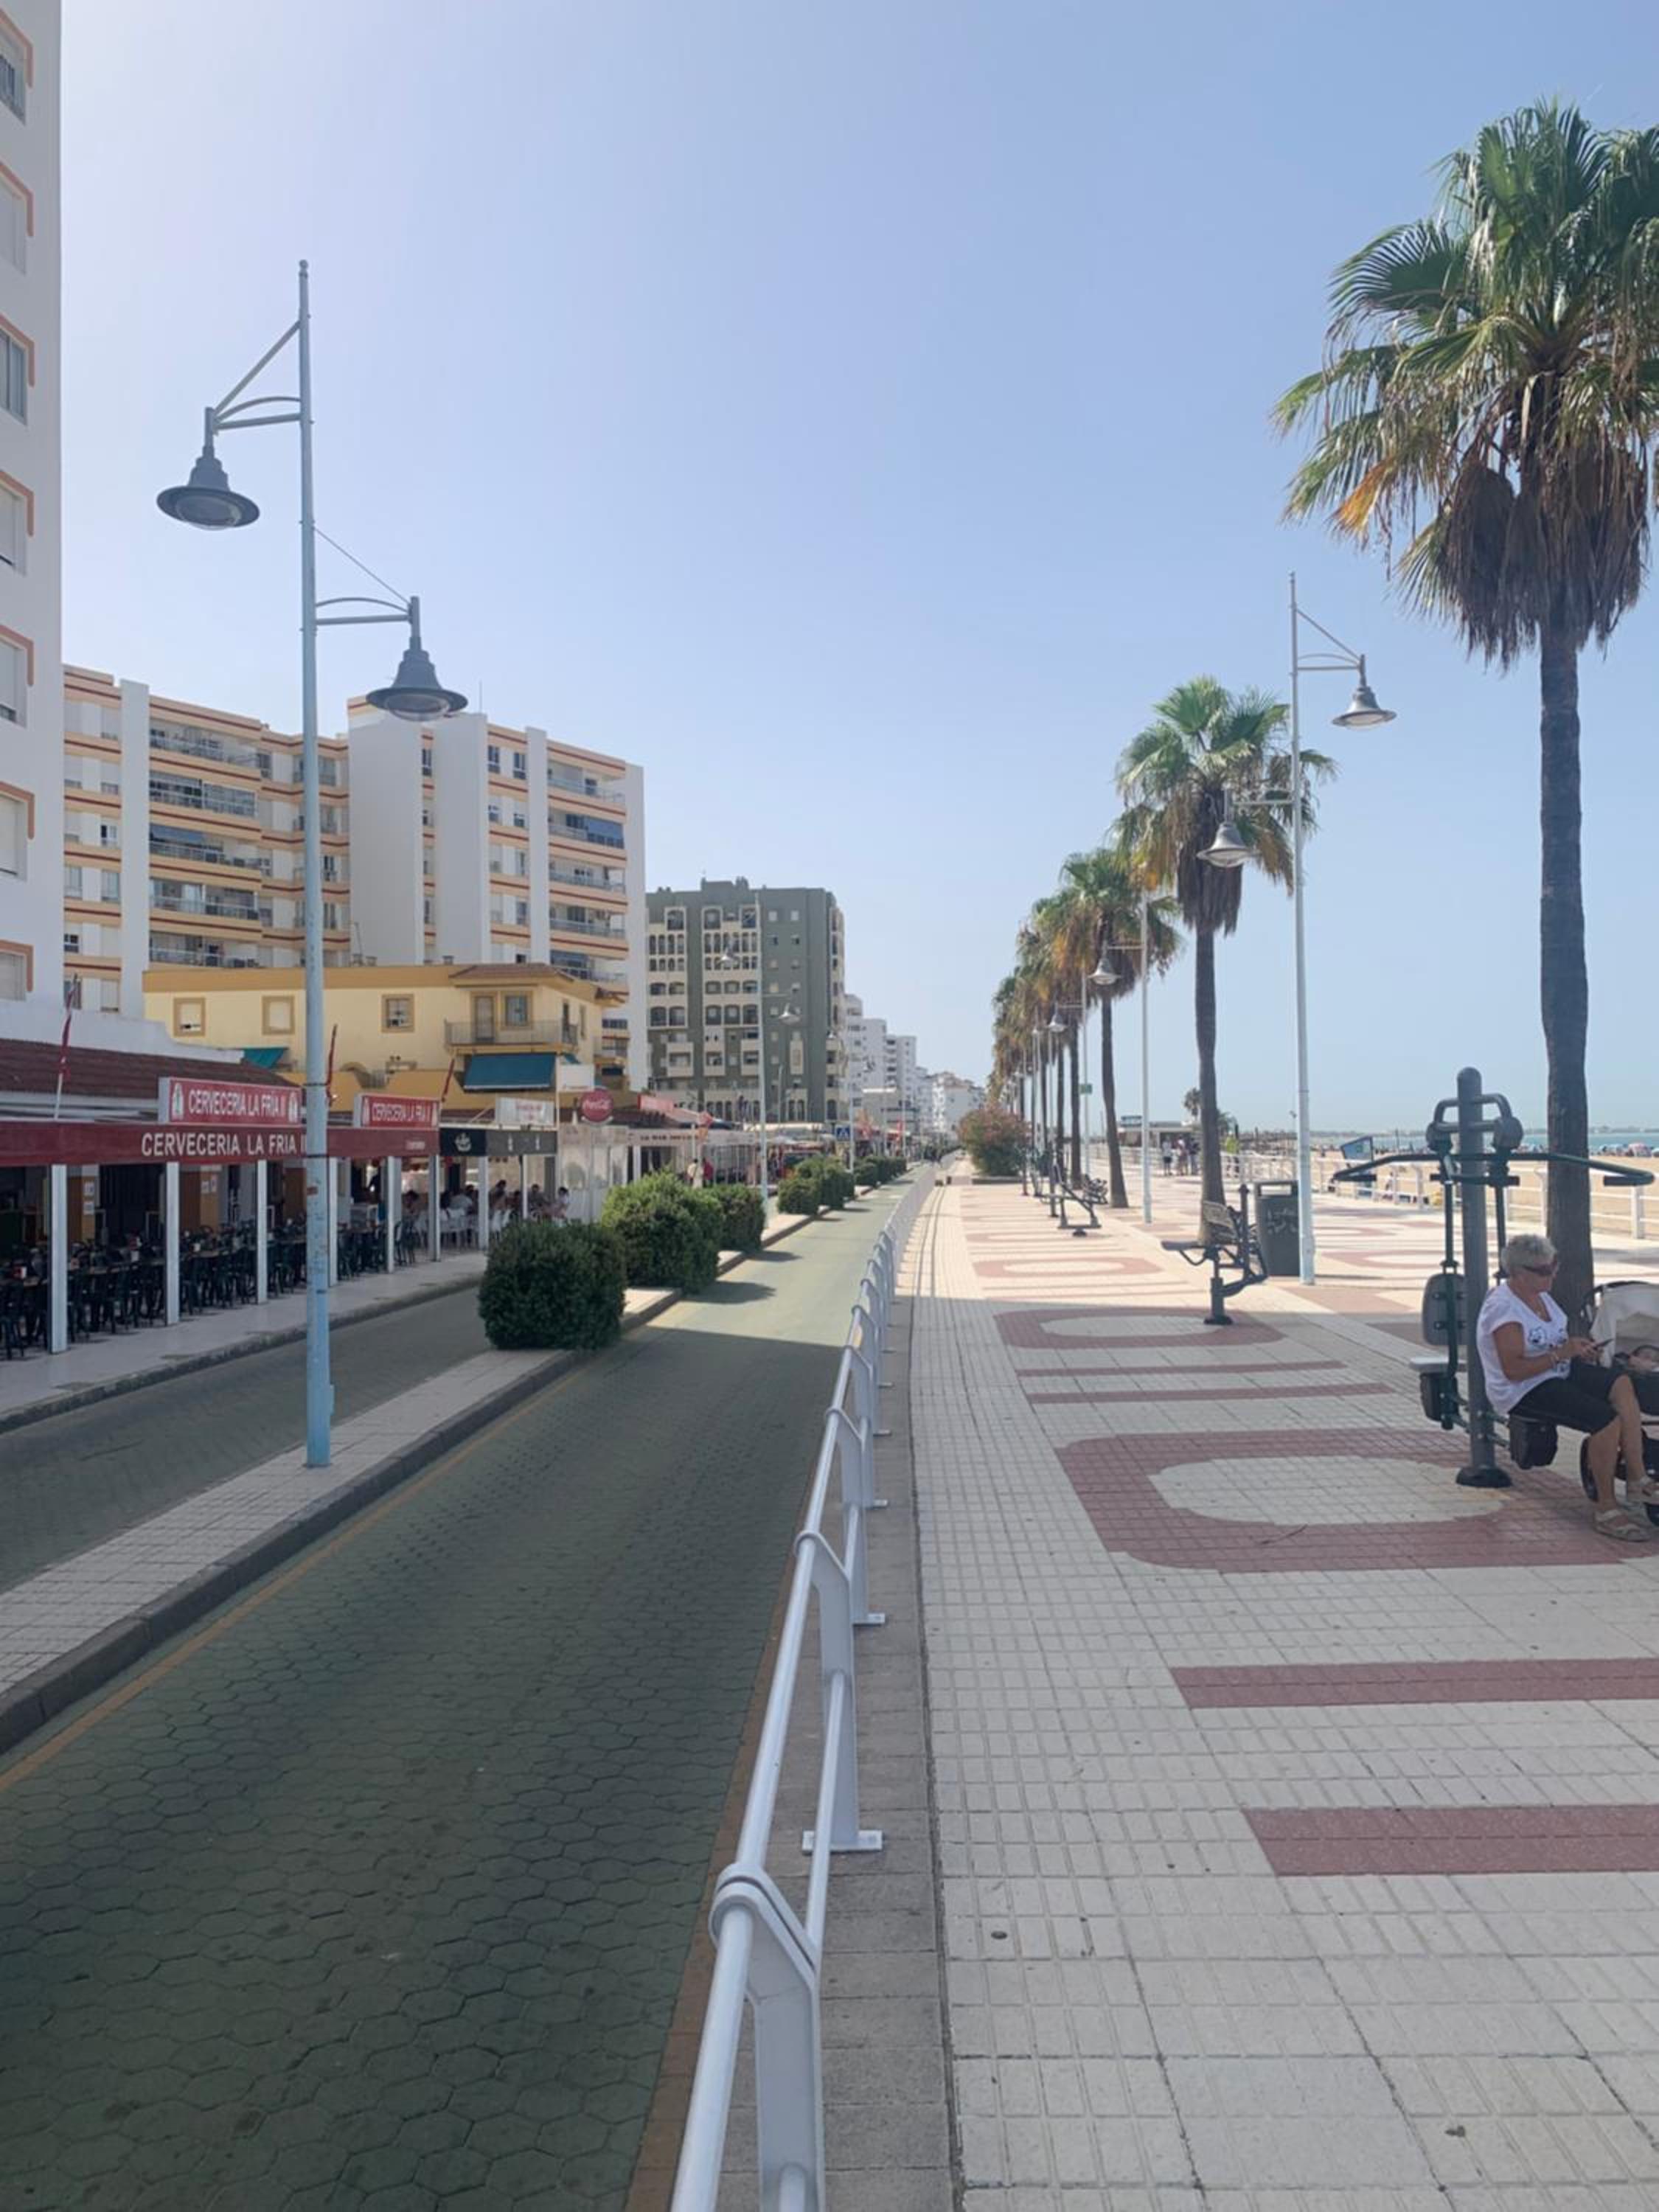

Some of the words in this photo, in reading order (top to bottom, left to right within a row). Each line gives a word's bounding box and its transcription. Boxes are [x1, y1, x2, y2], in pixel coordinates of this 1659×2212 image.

[247, 1094, 259, 1116] LA
[142, 1132, 240, 1156] CERVECERIA
[247, 1133, 265, 1155] LA
[269, 1133, 297, 1155] FRIA
